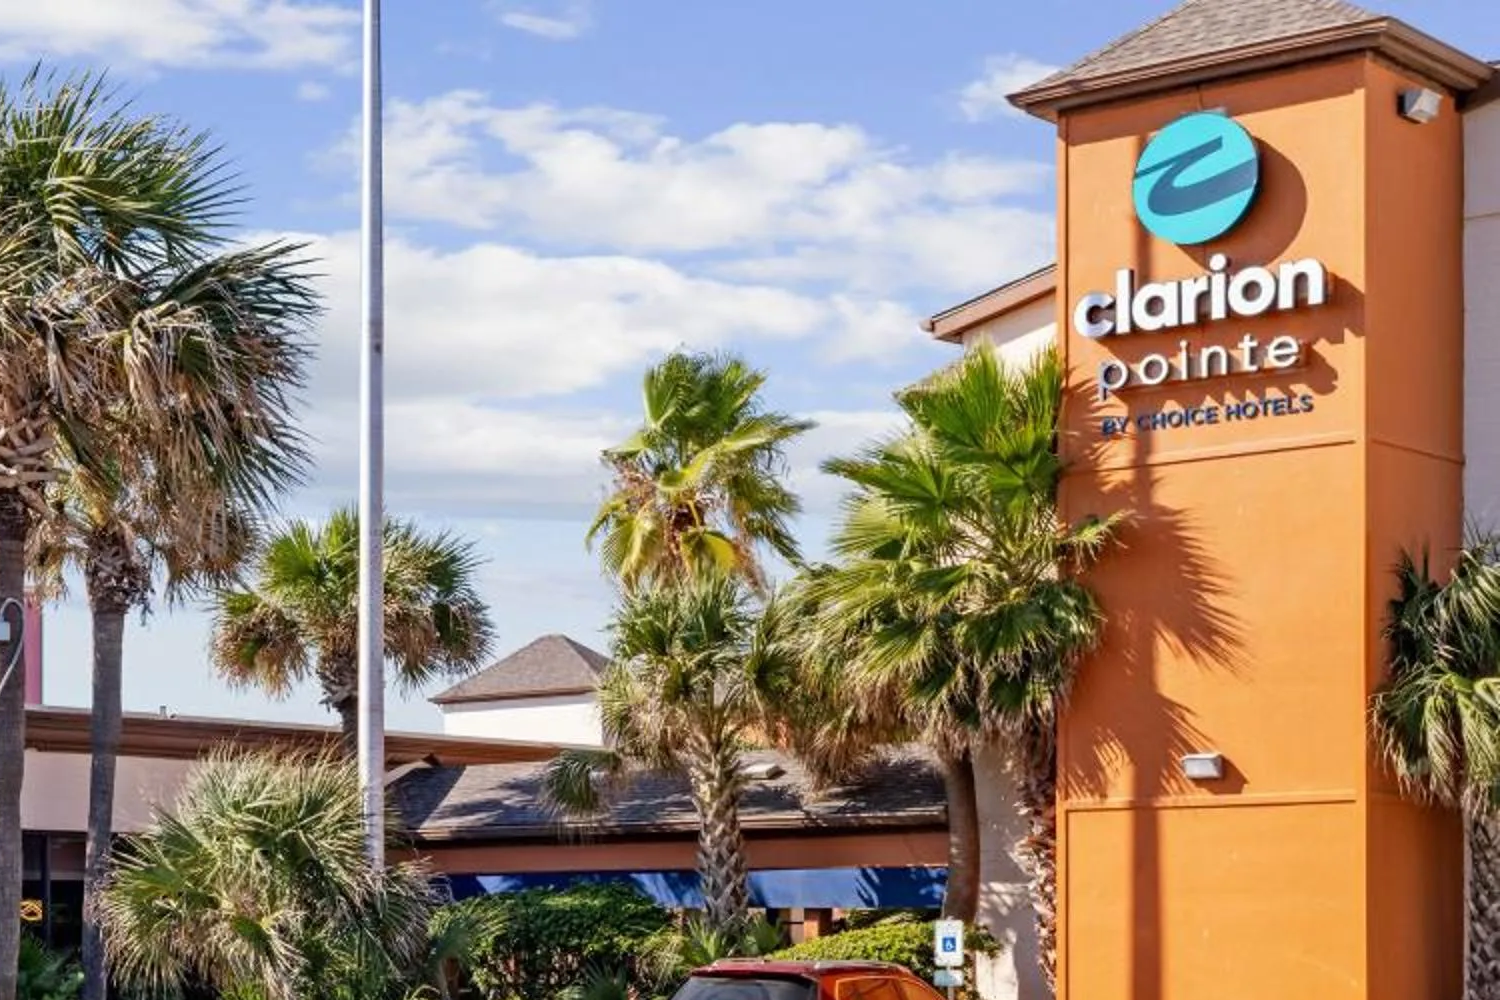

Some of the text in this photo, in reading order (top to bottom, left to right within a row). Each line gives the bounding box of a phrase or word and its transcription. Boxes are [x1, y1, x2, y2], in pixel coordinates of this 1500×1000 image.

[1073, 253, 1325, 339] clarion
[1098, 332, 1300, 401] pointe
[1102, 394, 1315, 436] BY CHOICE HOTELS
